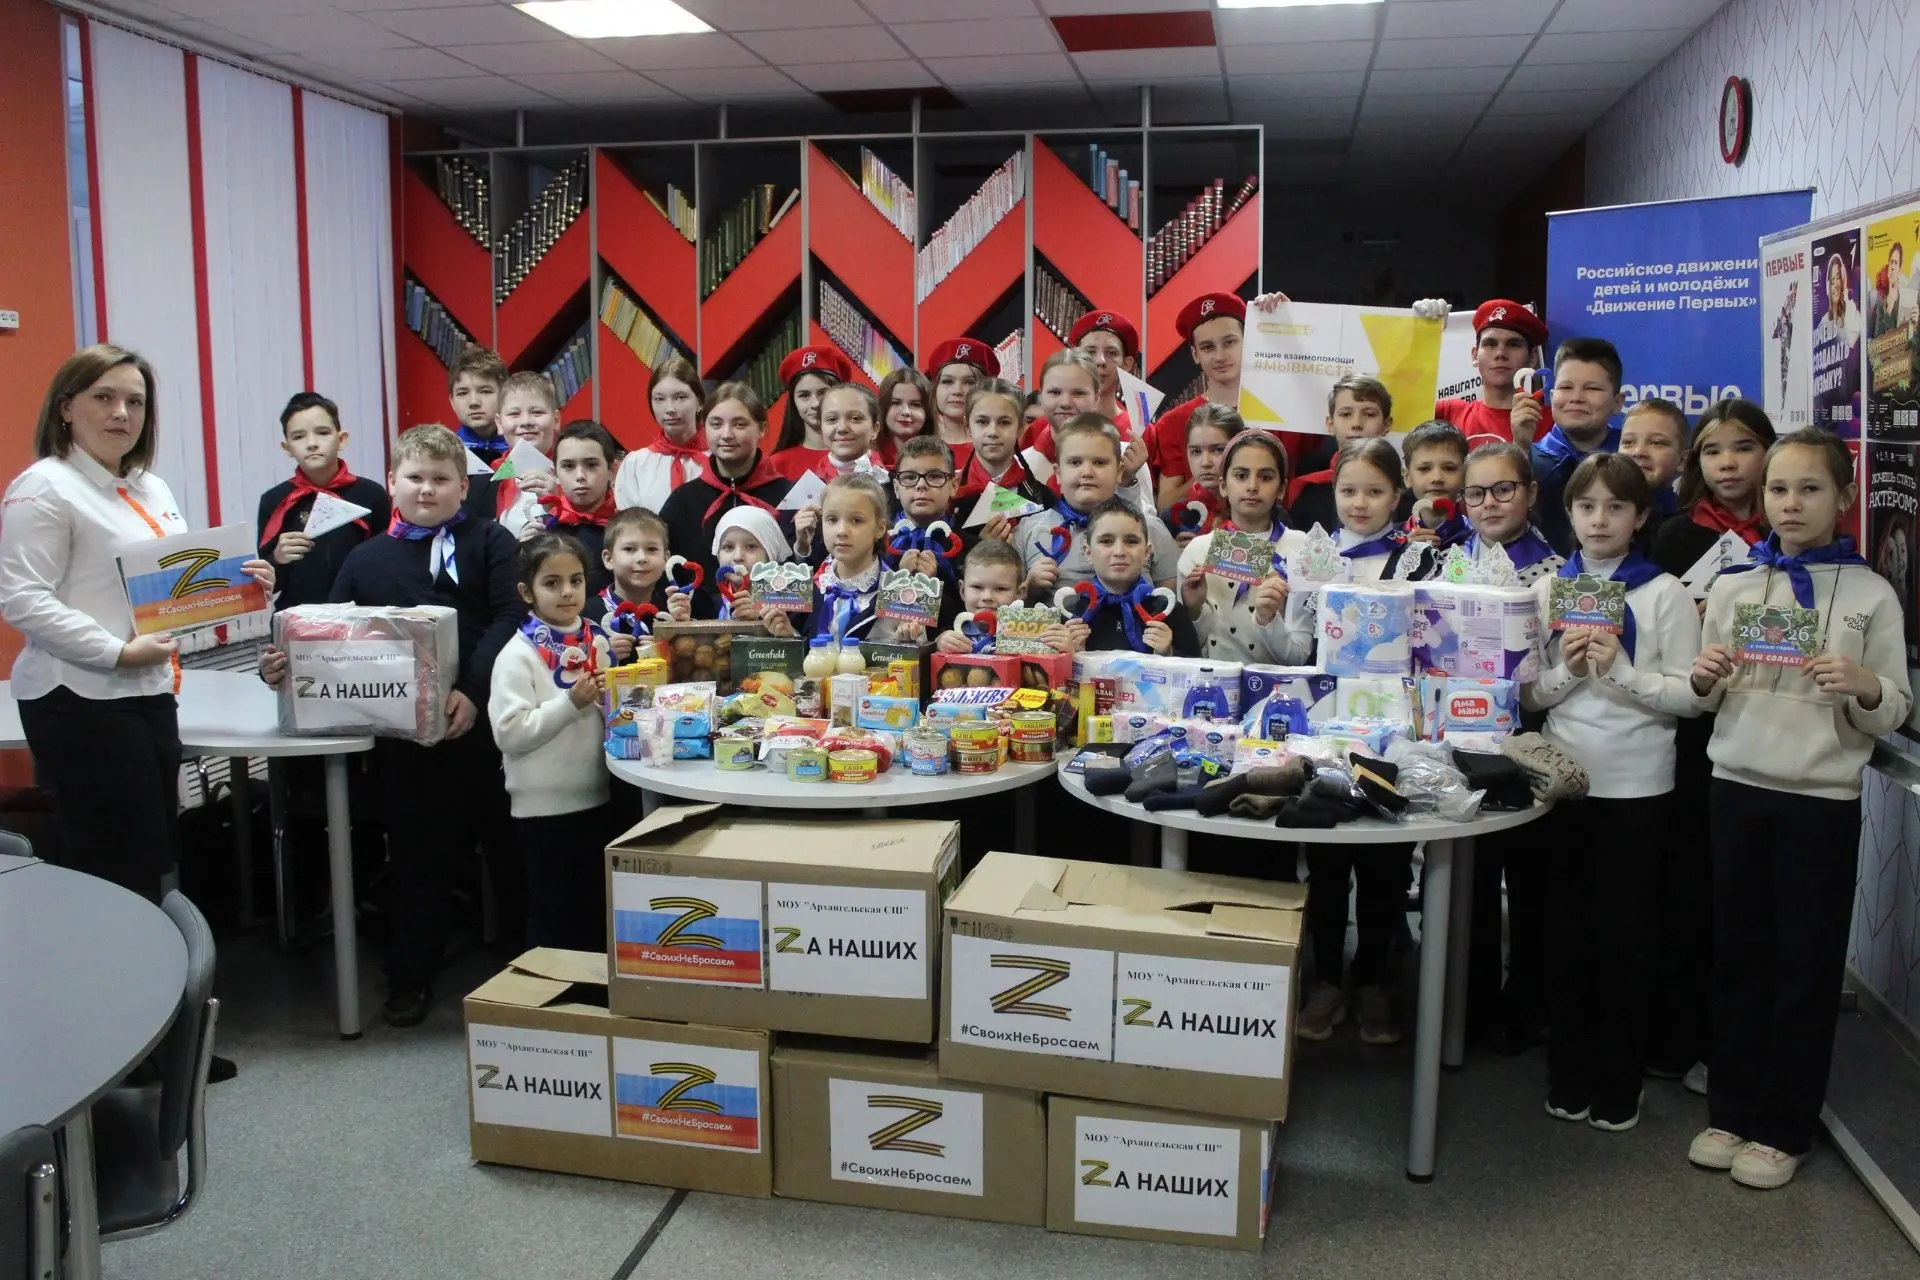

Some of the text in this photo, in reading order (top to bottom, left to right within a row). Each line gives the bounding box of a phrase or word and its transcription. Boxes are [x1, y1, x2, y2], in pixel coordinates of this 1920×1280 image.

[1577, 257, 1760, 279] Российское движени
[1765, 252, 1805, 278] ПЕРВЫЕ
[1594, 276, 1749, 297] детей и молодёжи
[1586, 296, 1757, 315] «Движение Первых»
[1254, 351, 1354, 364] акция взаимопомощи
[1438, 376, 1483, 399] НАВИГАТО
[1869, 486, 1918, 515] АКТЁРОМ?
[158, 594, 242, 616] #СвоихНеБросаем
[1740, 626, 1810, 641] 20 26
[748, 650, 786, 660] Greenfield
[1743, 652, 1804, 664] НАШ СОЛДАТ!
[337, 682, 407, 698] НАШИХ
[776, 899, 909, 914] МОУ "Архангельская СШ"
[641, 950, 735, 966] #СвоихНеБросаем
[829, 938, 918, 960] НАШИХ
[1127, 970, 1271, 991] МОУ "Архангельская СШ"
[1182, 1011, 1277, 1038] НАШИХ
[961, 1024, 1100, 1050] #СвоихНеБросаем
[476, 1039, 593, 1057] МОУ "Архангельская СШ"
[525, 1076, 602, 1100] НАШИХ
[641, 1112, 733, 1132] #СвоихНеБросаем
[1084, 1133, 1223, 1152] МОУ "Архангельская СШ"
[840, 1160, 972, 1187] #СвоихНеБросаем
[1137, 1171, 1229, 1199] НАШИХ
